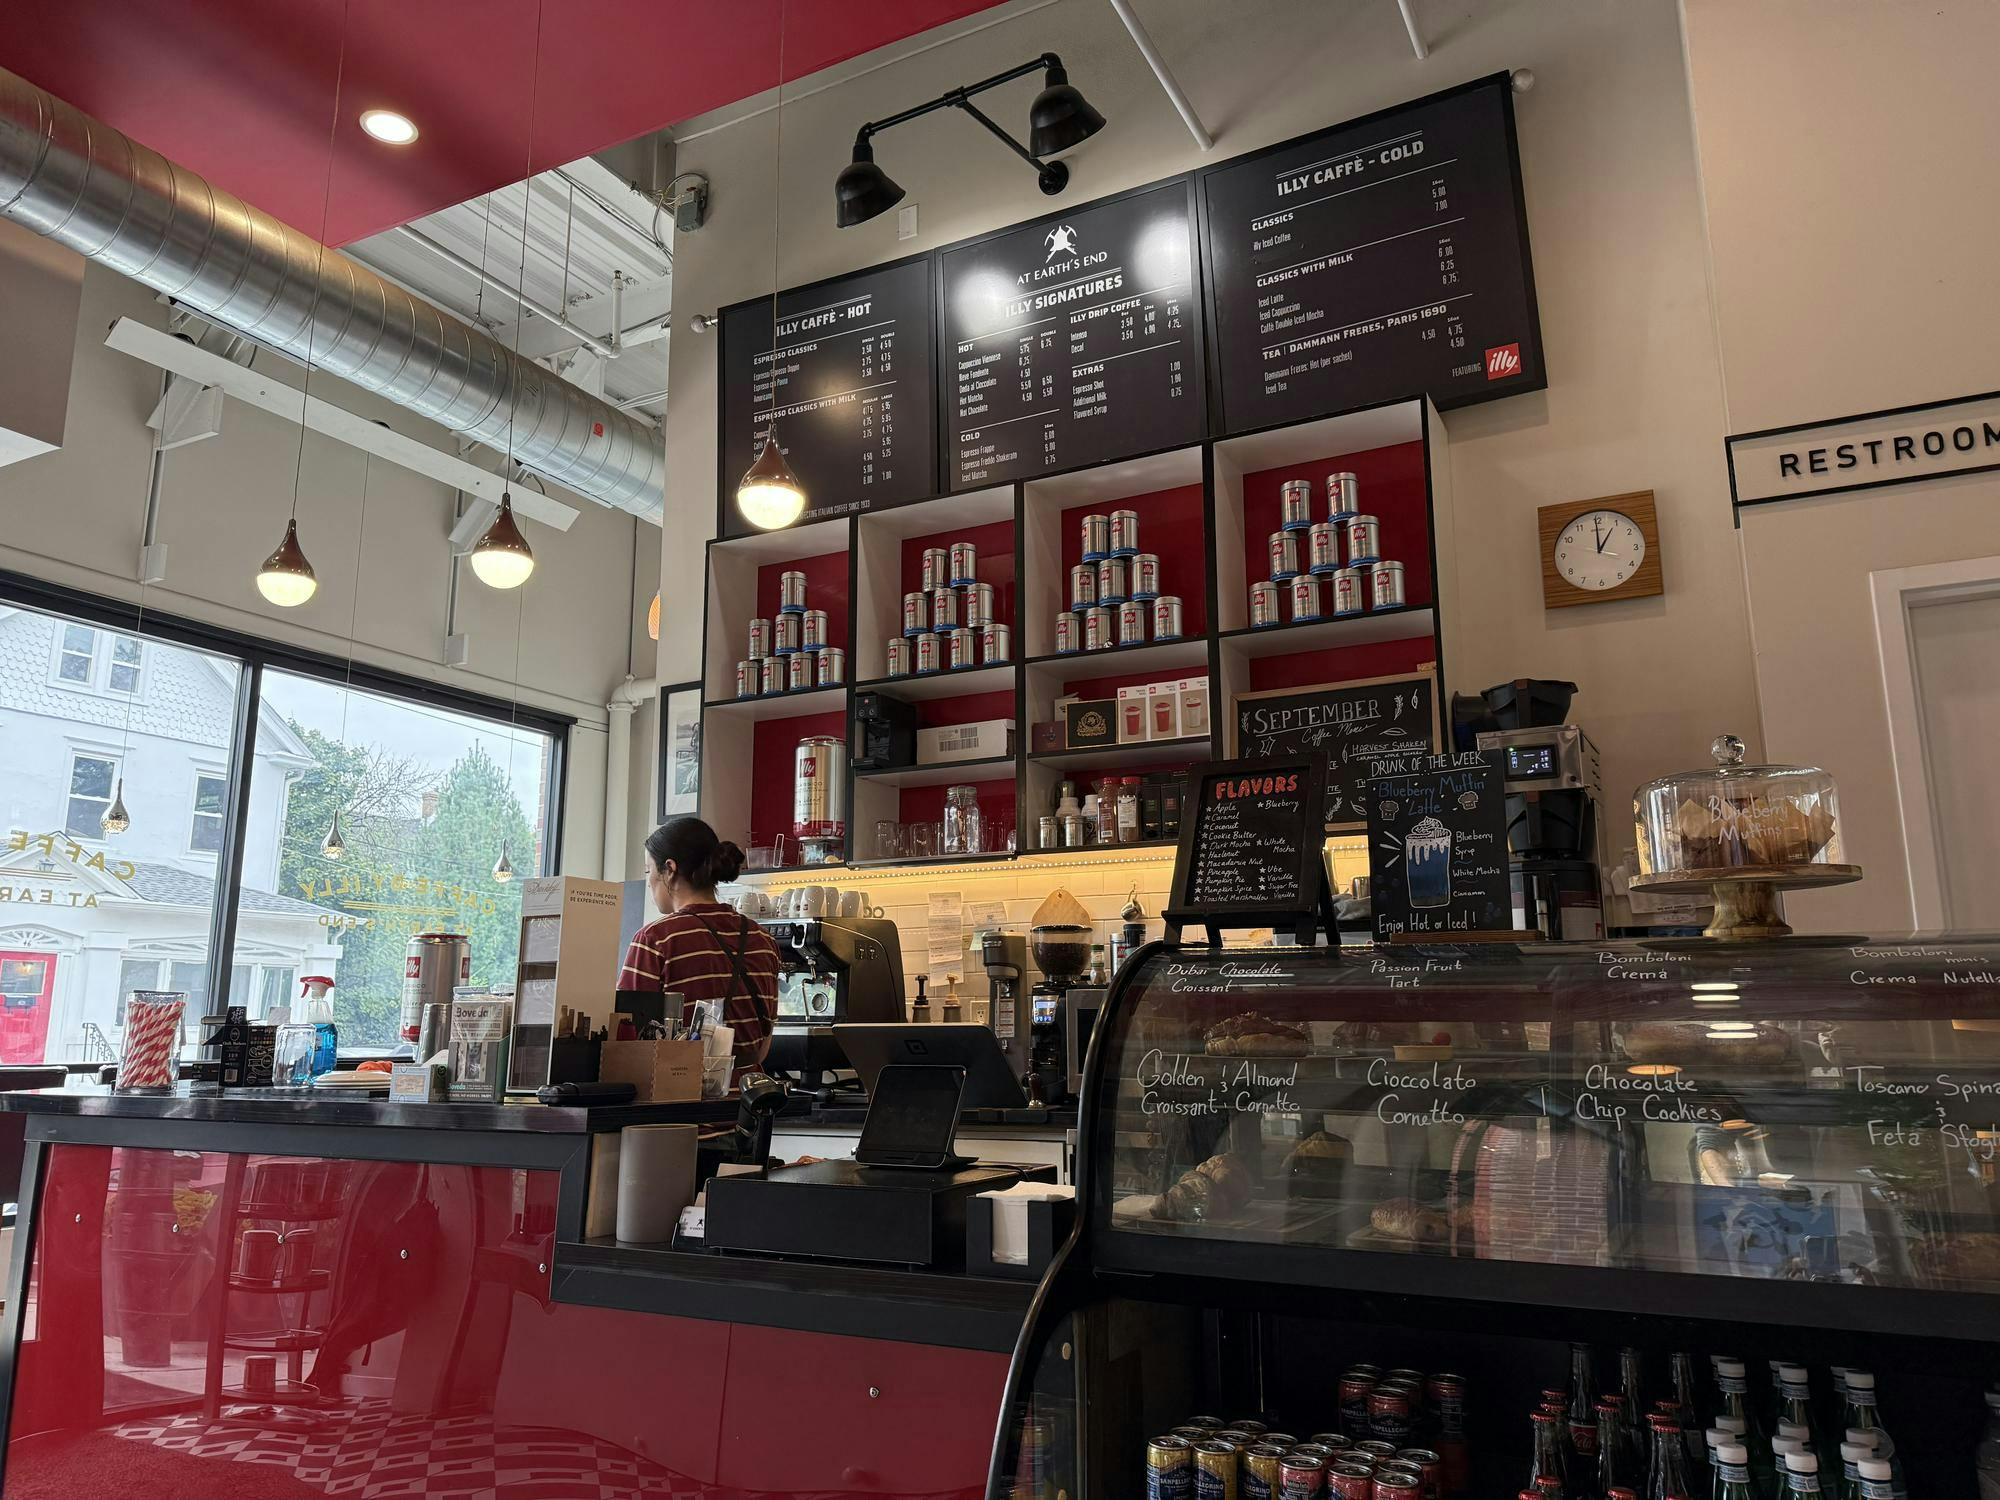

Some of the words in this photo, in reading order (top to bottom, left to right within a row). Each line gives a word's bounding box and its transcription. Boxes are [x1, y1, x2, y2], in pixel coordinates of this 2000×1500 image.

[1277, 174, 1310, 197] ILLY
[1313, 156, 1365, 185] CAFFÈ
[1380, 140, 1425, 165] COLD
[1252, 212, 1294, 231] CLASSICS
[1262, 237, 1274, 248] Iced
[1274, 232, 1291, 245] Coffee
[1016, 272, 1030, 286] AT
[1034, 257, 1080, 280] EARTH'S
[1083, 250, 1108, 268] END
[1256, 268, 1299, 288] CLASSICS
[1300, 261, 1326, 275] WITH
[1328, 253, 1354, 267] MILK
[1004, 299, 1032, 319] ILLY
[1035, 274, 1123, 311] SIGNATURES
[1070, 313, 1086, 324] ILLY
[1088, 307, 1109, 320] DRIP
[1111, 299, 1141, 313] COFFEE
[776, 321, 799, 337] ILLY
[801, 309, 836, 331] CAFFÈ
[847, 302, 872, 319] HOT
[1121, 317, 1133, 329] 3.50
[1262, 349, 1281, 360] TEA
[1289, 333, 1341, 353] DAMMANN
[1343, 322, 1385, 339] FRERES,
[1387, 313, 1418, 327] PARIS
[1420, 304, 1447, 319] 1690
[753, 351, 786, 366] ESPRESSO
[787, 343, 818, 357] CLASSICS
[958, 343, 974, 354] HOT
[1490, 350, 1518, 374] illy
[1072, 364, 1104, 378] EXTRAS
[1452, 363, 1482, 377] FEATURING
[788, 403, 818, 415] CLASSICS
[819, 397, 837, 409] WITH
[838, 394, 856, 405] MILK
[960, 432, 980, 442] COLD
[1780, 422, 2000, 478] RESTROOM
[1576, 524, 1584, 532] 11
[1627, 528, 1632, 536] 2
[1599, 579, 1605, 587] 6
[1253, 699, 1381, 734] SEPTEMBER
[1302, 728, 1332, 747] Coffee
[1352, 744, 1389, 755] HARVEST
[1392, 740, 1427, 751] SHAKEN
[1371, 759, 1409, 778] DRINK
[1411, 757, 1422, 771] OF
[1427, 755, 1447, 769] THE
[1452, 750, 1485, 767] WEEK
[1215, 774, 1299, 800] FLAVORS
[1378, 778, 1435, 801] Blueberry
[1439, 773, 1485, 794] Muffin
[1213, 802, 1236, 815] Apple
[1265, 799, 1299, 812] Blueberry
[1408, 799, 1442, 816] Latte
[1708, 792, 1788, 824] Blueberry
[1211, 812, 1240, 821] Caramel
[1209, 822, 1239, 831] Coconut
[1208, 832, 1231, 841] Cookie
[1232, 831, 1256, 839] Butter
[1456, 830, 1493, 845] Blueberry
[1718, 824, 1782, 845] Muffins
[1209, 842, 1227, 851] Dark
[1230, 840, 1251, 848] Mocha
[1272, 845, 1295, 853] Mocha
[1455, 846, 1475, 860] Syrup
[1248, 857, 1264, 865] Nut
[1206, 869, 1239, 877] Pineapple
[1453, 868, 1474, 878] White
[1475, 866, 1501, 876] Mocha
[1205, 876, 1232, 885] Pumpkin
[1267, 882, 1287, 892] Sugar
[1204, 885, 1233, 894] Pumpkin
[1234, 884, 1252, 892] Spice
[1273, 892, 1295, 900] Vanilla
[577, 897, 604, 905] EXPERIENCE
[1203, 894, 1228, 902] Toasted
[1230, 893, 1269, 902] Marshmallow
[1378, 913, 1404, 936] Enjoy
[1410, 911, 1430, 931] Hot
[1434, 919, 1442, 929] or
[1448, 909, 1467, 930] Iced
[1597, 951, 1692, 965] Bomboloni
[1167, 963, 1208, 976] Dubai
[1220, 961, 1282, 976] Chocolate
[1370, 959, 1421, 974] Passion
[1426, 958, 1463, 972] Fruit
[1171, 977, 1233, 993] Croissant
[1385, 975, 1421, 988] Tart
[1850, 970, 1917, 985] Crema
[456, 1007, 489, 1018] Boveda
[1137, 1048, 1205, 1088] Golden
[1232, 1060, 1298, 1087] Almond
[1367, 1058, 1477, 1091] Cioccolato
[1585, 1064, 1699, 1093] Chocolate
[1846, 1065, 1929, 1095] Toscano
[1141, 1088, 1218, 1117] Croissant
[1236, 1091, 1300, 1114] Cornetto
[1377, 1094, 1465, 1127] Cornetto
[1576, 1093, 1627, 1132] Chip
[1643, 1095, 1722, 1122] Cookies
[1868, 1119, 1921, 1146] Feta
